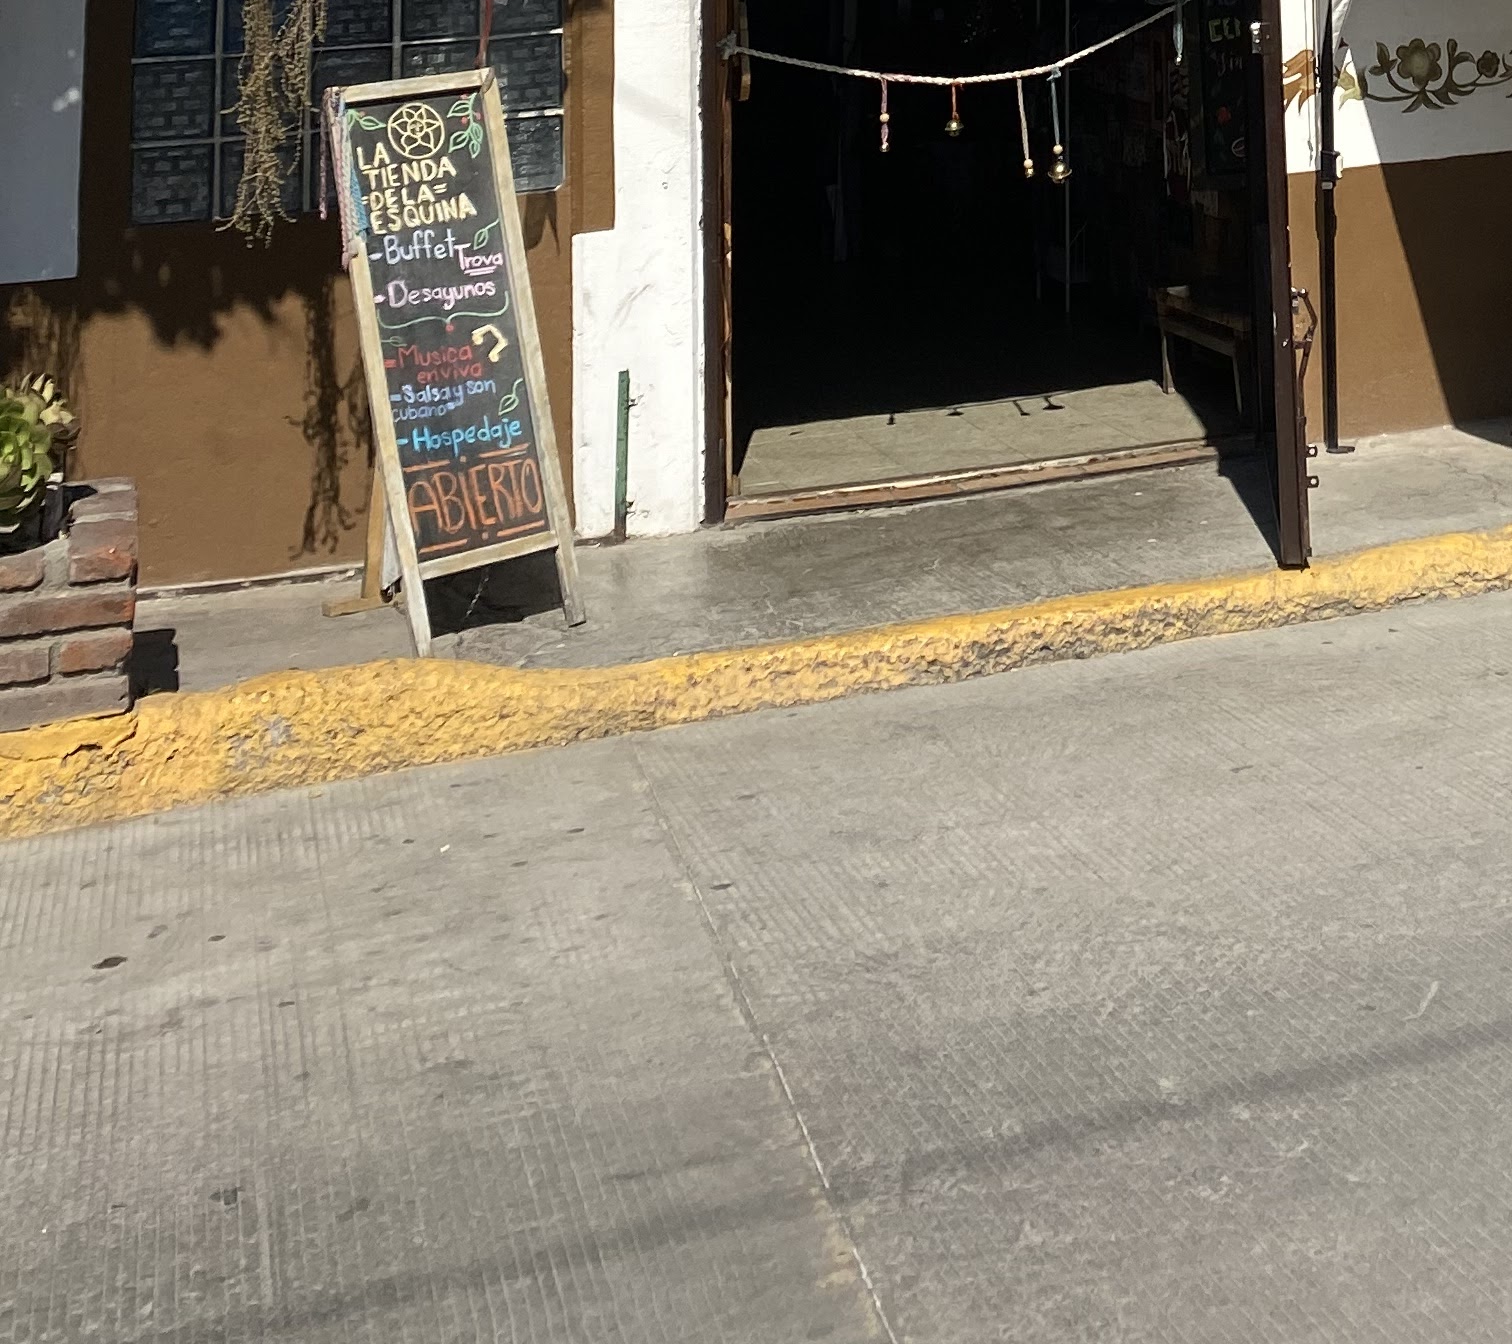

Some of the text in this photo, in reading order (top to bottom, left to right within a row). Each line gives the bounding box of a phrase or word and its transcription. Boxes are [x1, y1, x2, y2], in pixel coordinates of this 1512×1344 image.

[356, 142, 390, 170] LA
[362, 156, 457, 190] TIENDA
[370, 192, 478, 235] ESQUINA
[453, 243, 503, 271] Trova
[417, 369, 437, 384] en
[466, 380, 496, 395] son
[408, 459, 542, 536] ABIERTO
